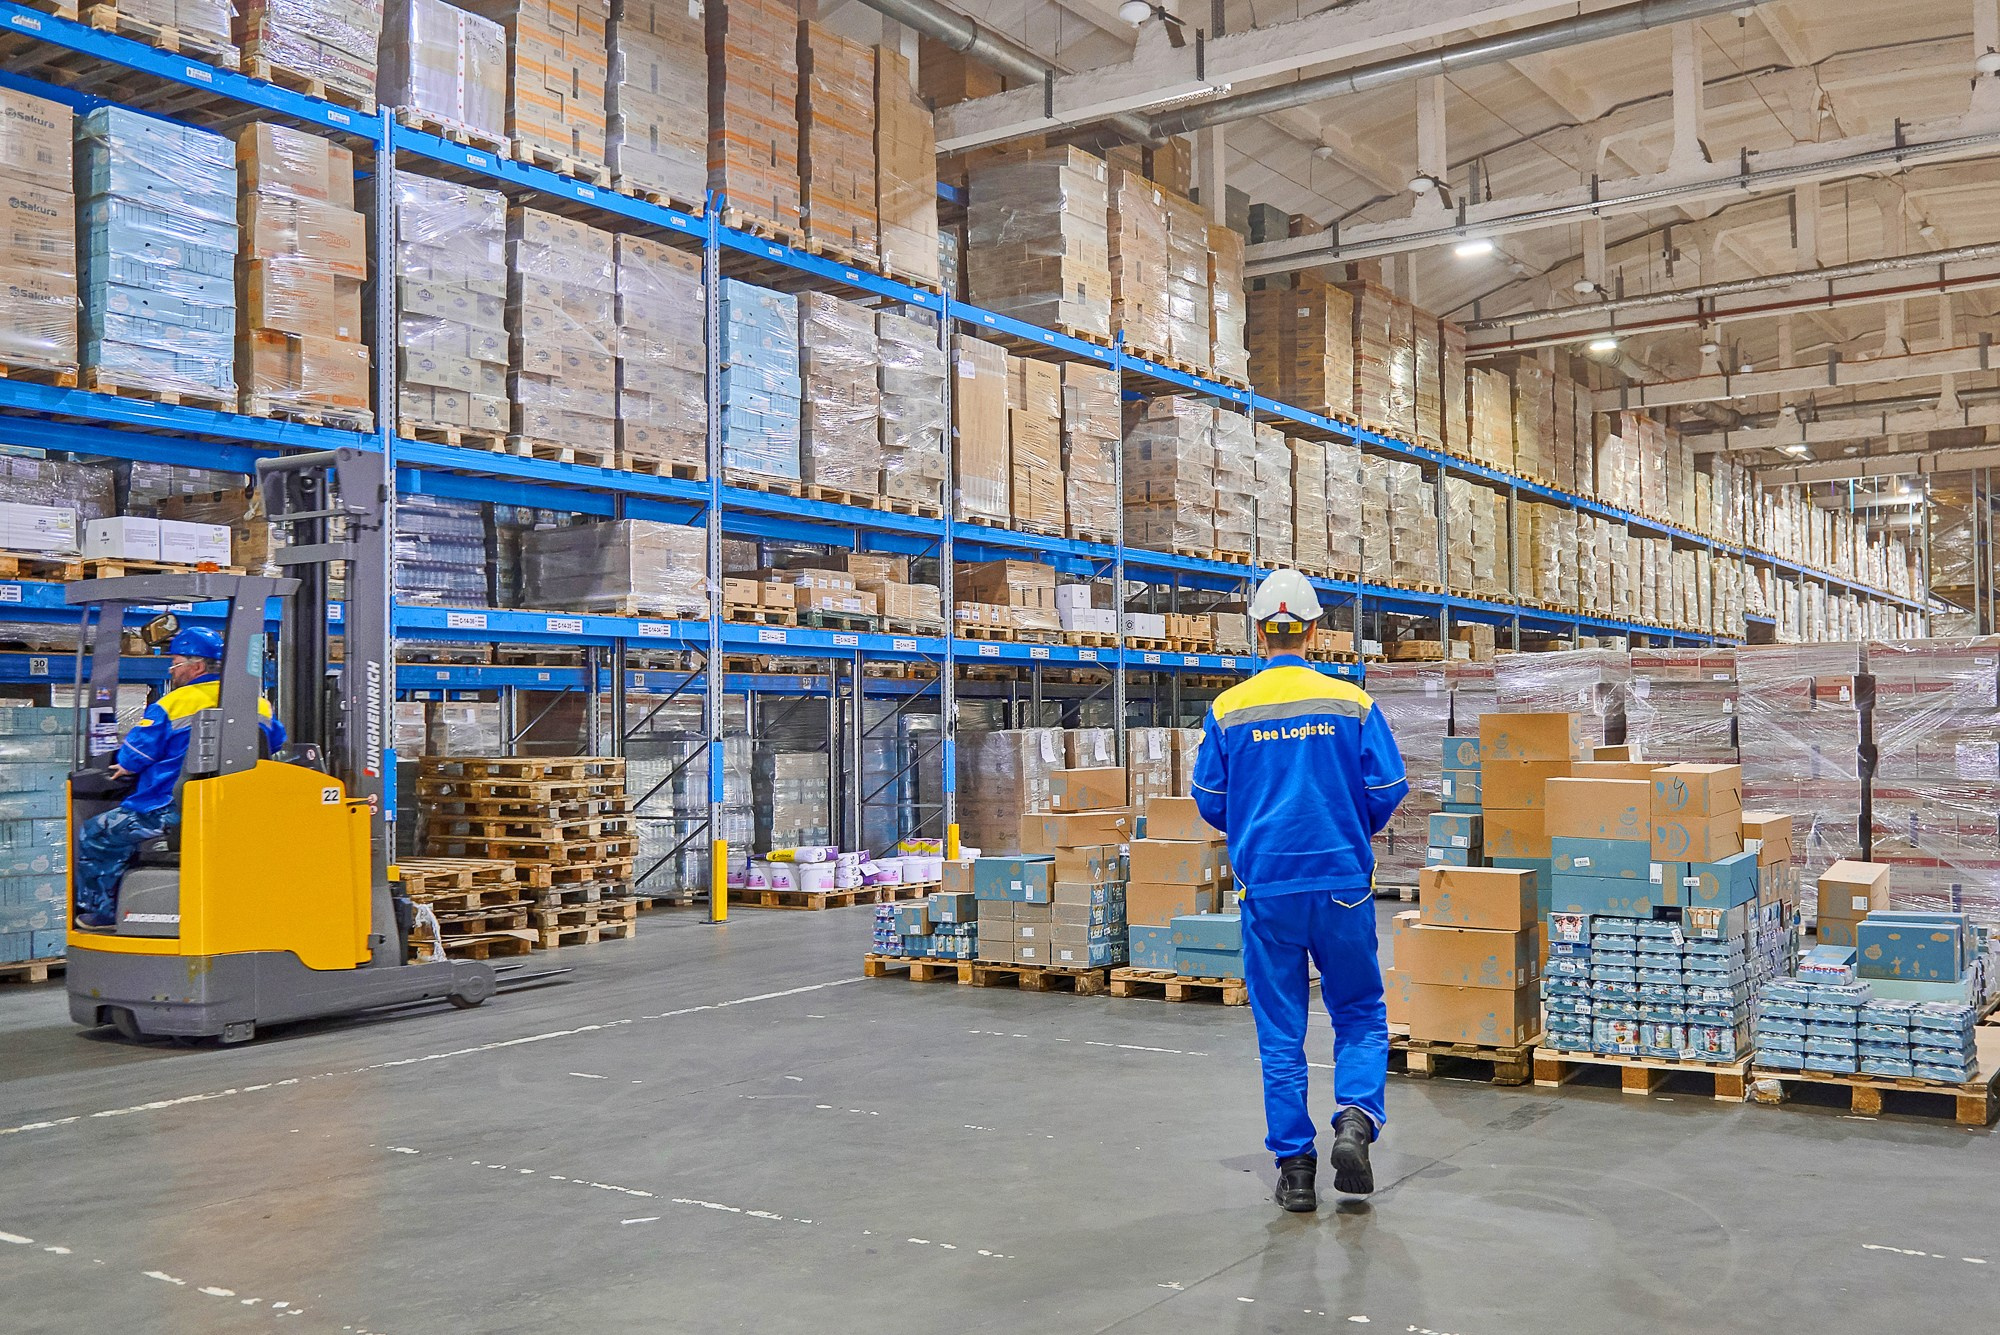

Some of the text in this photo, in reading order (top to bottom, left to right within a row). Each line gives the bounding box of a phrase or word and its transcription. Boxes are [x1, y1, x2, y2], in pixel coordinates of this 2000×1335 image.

[17, 110, 55, 129] Sakura
[20, 200, 57, 217] Sakura
[21, 289, 56, 302] Sakur
[363, 660, 380, 778] JUNGHEINRICH
[1252, 721, 1336, 742] Bee Logistic
[324, 790, 339, 802] 22
